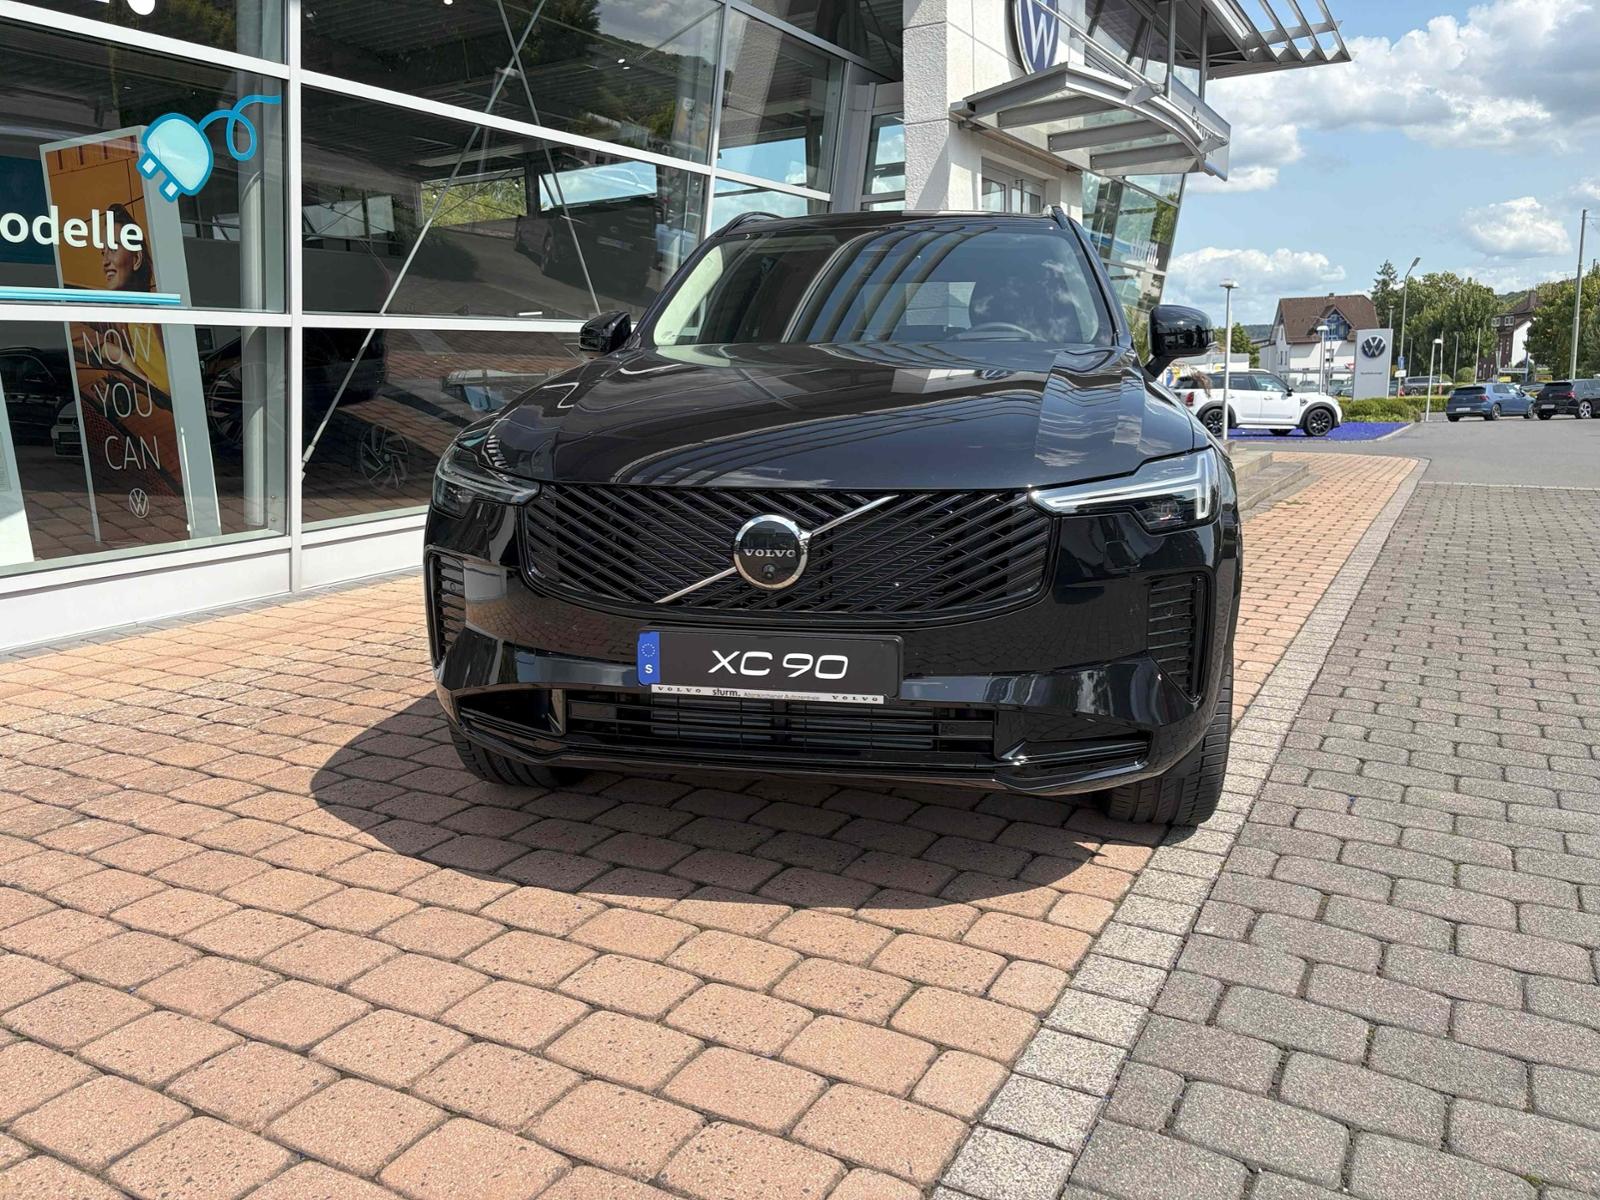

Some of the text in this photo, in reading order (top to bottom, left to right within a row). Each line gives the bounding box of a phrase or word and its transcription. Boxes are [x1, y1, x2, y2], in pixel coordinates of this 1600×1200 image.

[82, 327, 151, 365] NOW
[94, 382, 153, 418] YOU
[104, 435, 161, 470] CAN
[743, 549, 796, 557] VOLVO
[645, 664, 653, 674] S
[708, 650, 849, 680] XC 90
